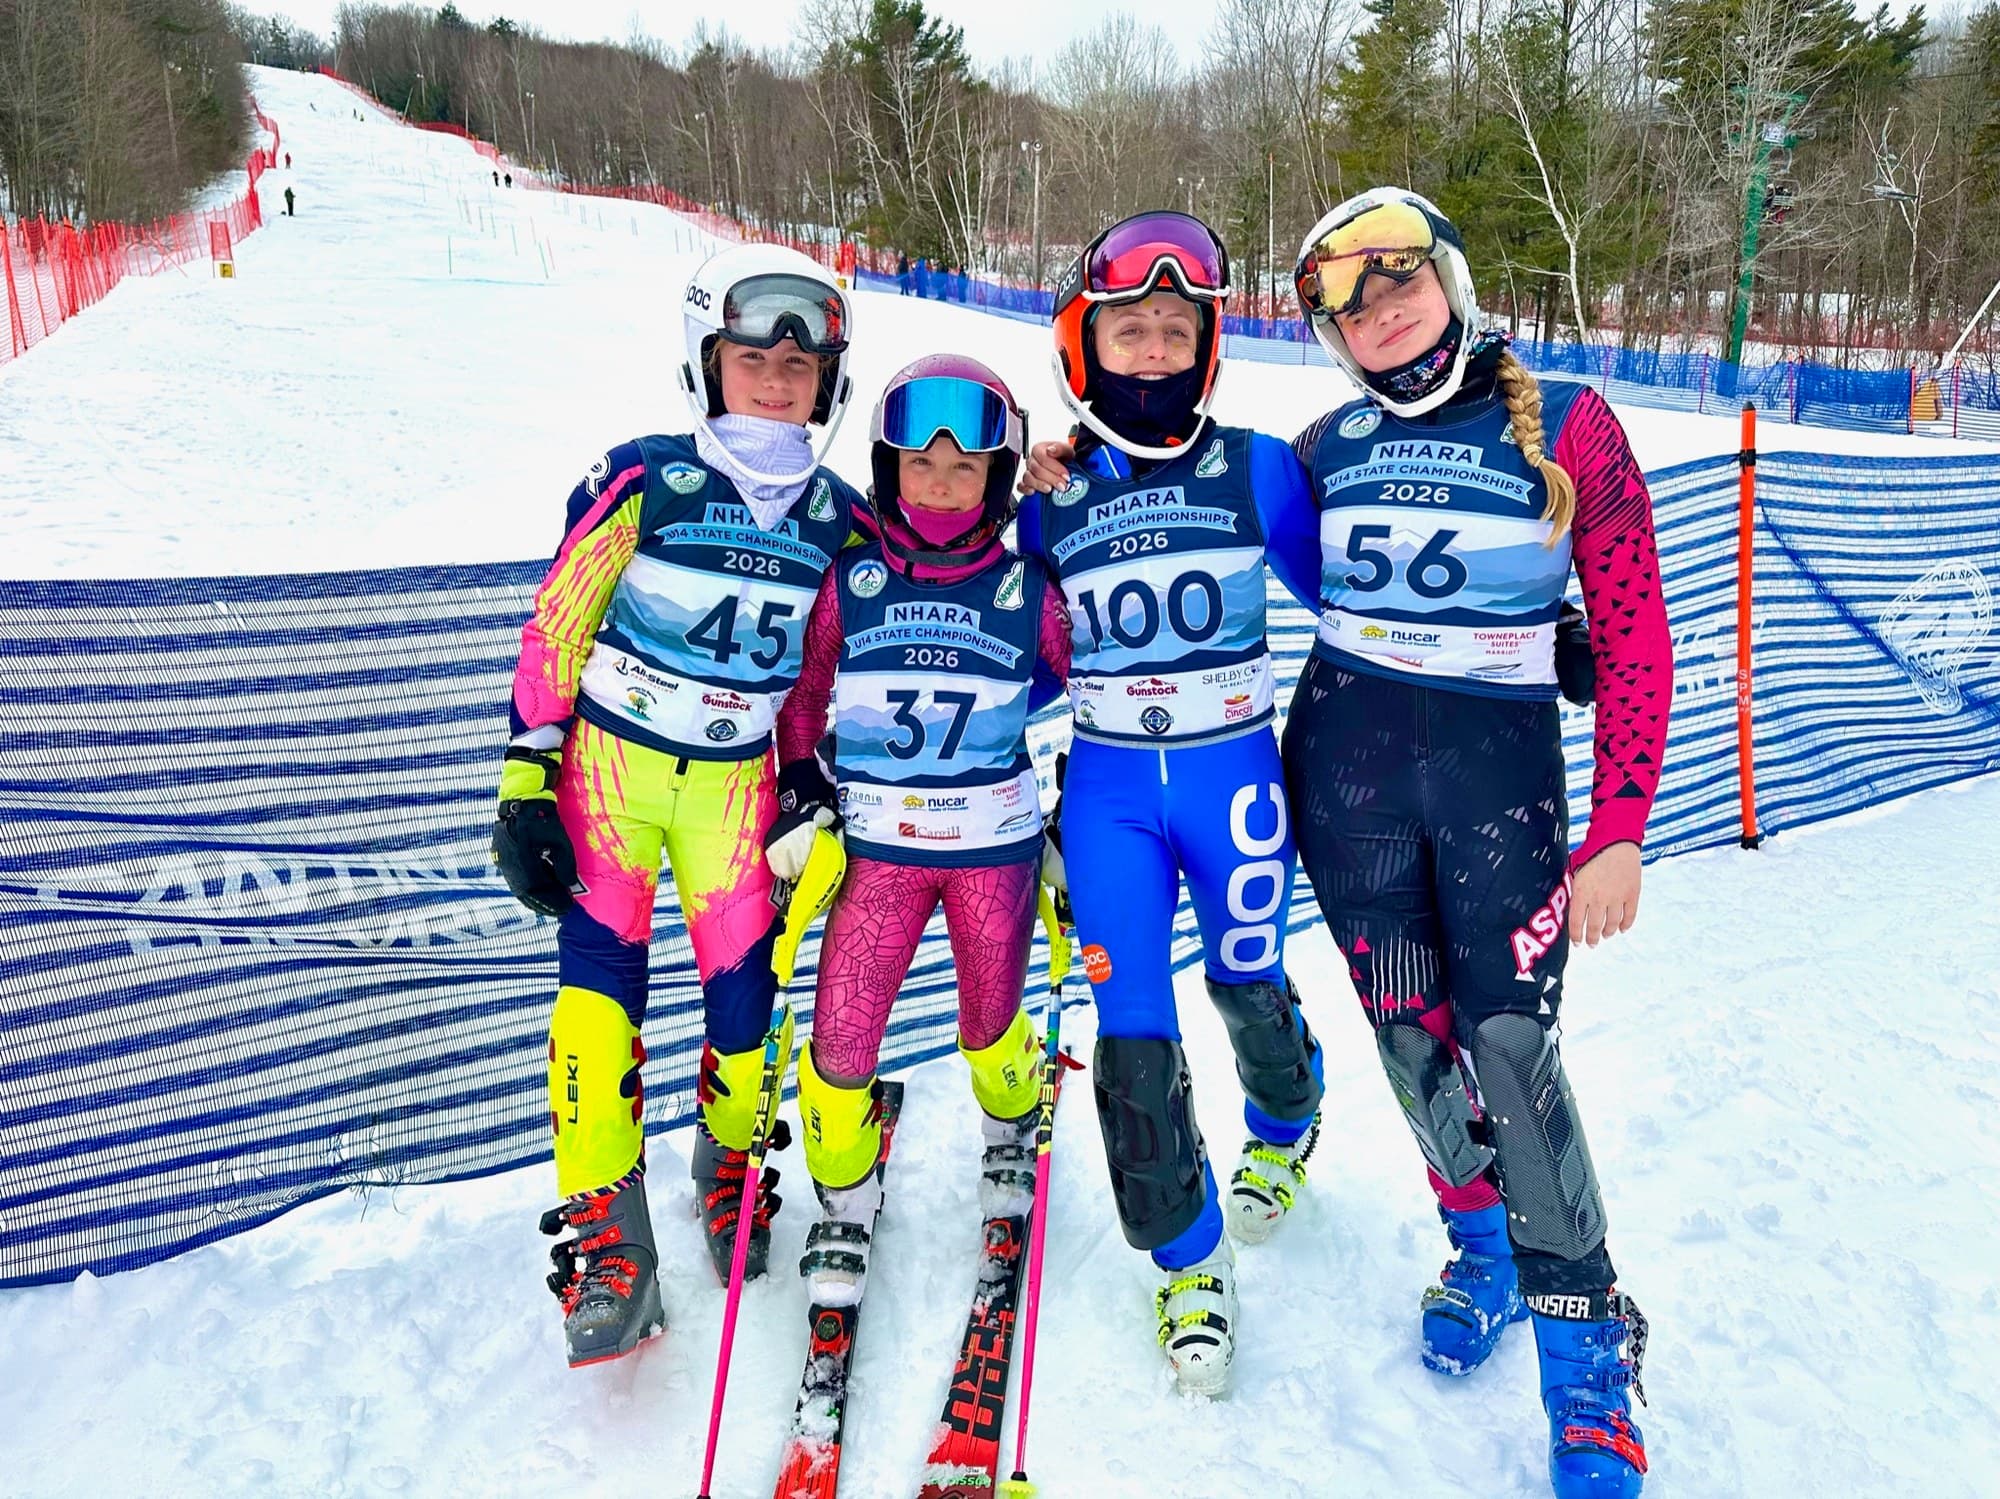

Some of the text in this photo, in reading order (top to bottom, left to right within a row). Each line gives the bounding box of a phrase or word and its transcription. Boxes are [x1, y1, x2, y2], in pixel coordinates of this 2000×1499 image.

[1378, 444, 1473, 464] NHARA
[1330, 464, 1523, 495] U14 STATE CHAMPIONSHIPS
[1378, 483, 1450, 504] 2026
[1096, 490, 1177, 521] NHARA
[665, 528, 689, 540] U14
[692, 528, 733, 541] STATE
[712, 507, 793, 538] NHA
[1059, 511, 1229, 555] U14 STATE CHAMPIONSHIPS
[1109, 531, 1169, 559] 2026
[723, 551, 781, 577] 2026
[1345, 524, 1468, 599] 56
[893, 606, 973, 626] NHARA
[1078, 570, 1222, 653] 100
[684, 594, 795, 670] 45
[854, 628, 1014, 661] U14 STATE CHAMPIONSHIPS
[1391, 630, 1441, 643] nucar
[904, 648, 959, 668] 2026
[1126, 685, 1178, 696] Gunstock
[1202, 668, 1242, 685] SHELBY
[702, 695, 752, 711] Gunstock
[884, 689, 977, 760] 37
[928, 797, 967, 807] nucar
[1511, 868, 1572, 973] ASP
[567, 1054, 578, 1124] LEKI
[1002, 1063, 1019, 1091] LEKI
[752, 1069, 773, 1142] LEKI
[1039, 1063, 1056, 1132] LEKI
[810, 1106, 822, 1143] LEKI
